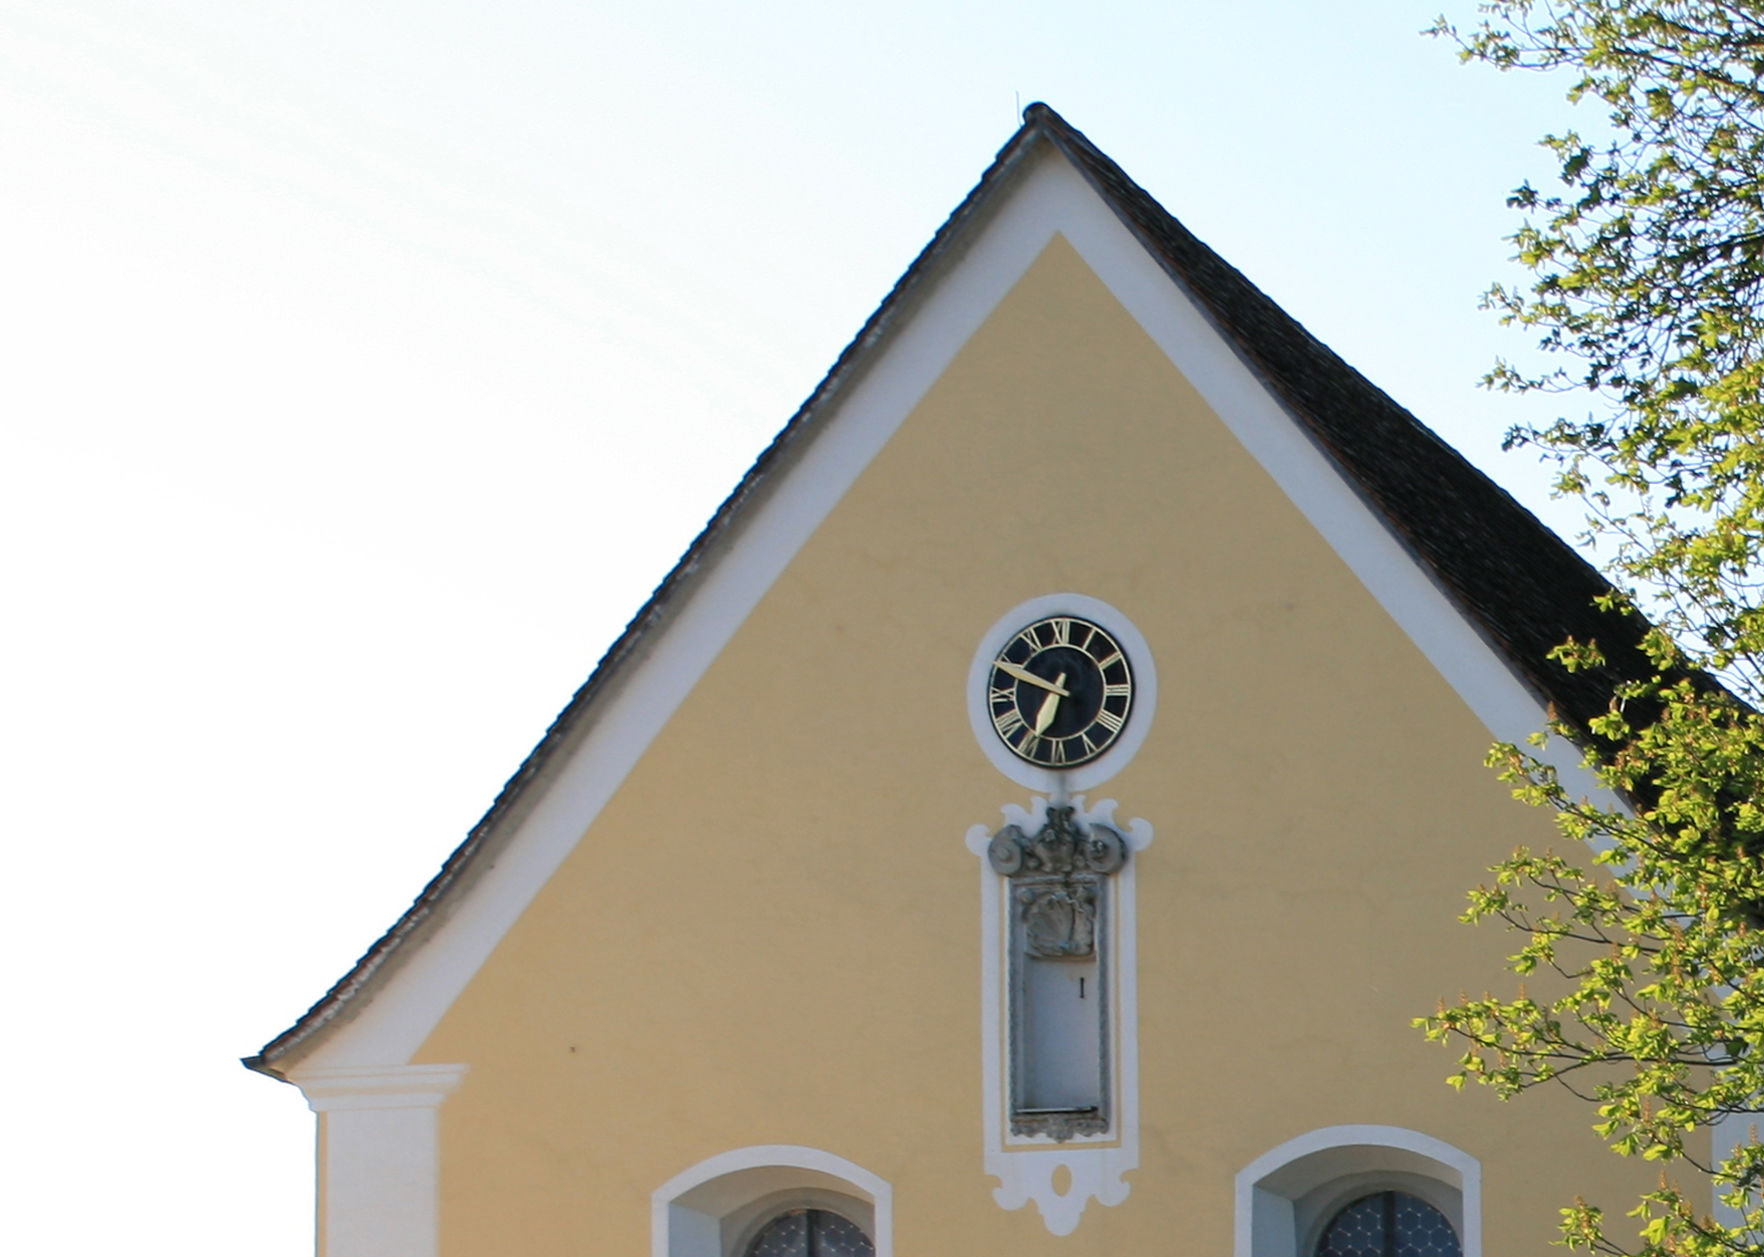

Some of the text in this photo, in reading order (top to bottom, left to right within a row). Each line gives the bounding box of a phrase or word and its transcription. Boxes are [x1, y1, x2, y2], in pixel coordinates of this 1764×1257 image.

[1019, 628, 1042, 652] XI
[1051, 620, 1070, 645] XII
[991, 686, 1015, 702] IX
[1105, 684, 1128, 697] III
[1082, 732, 1098, 755] V
